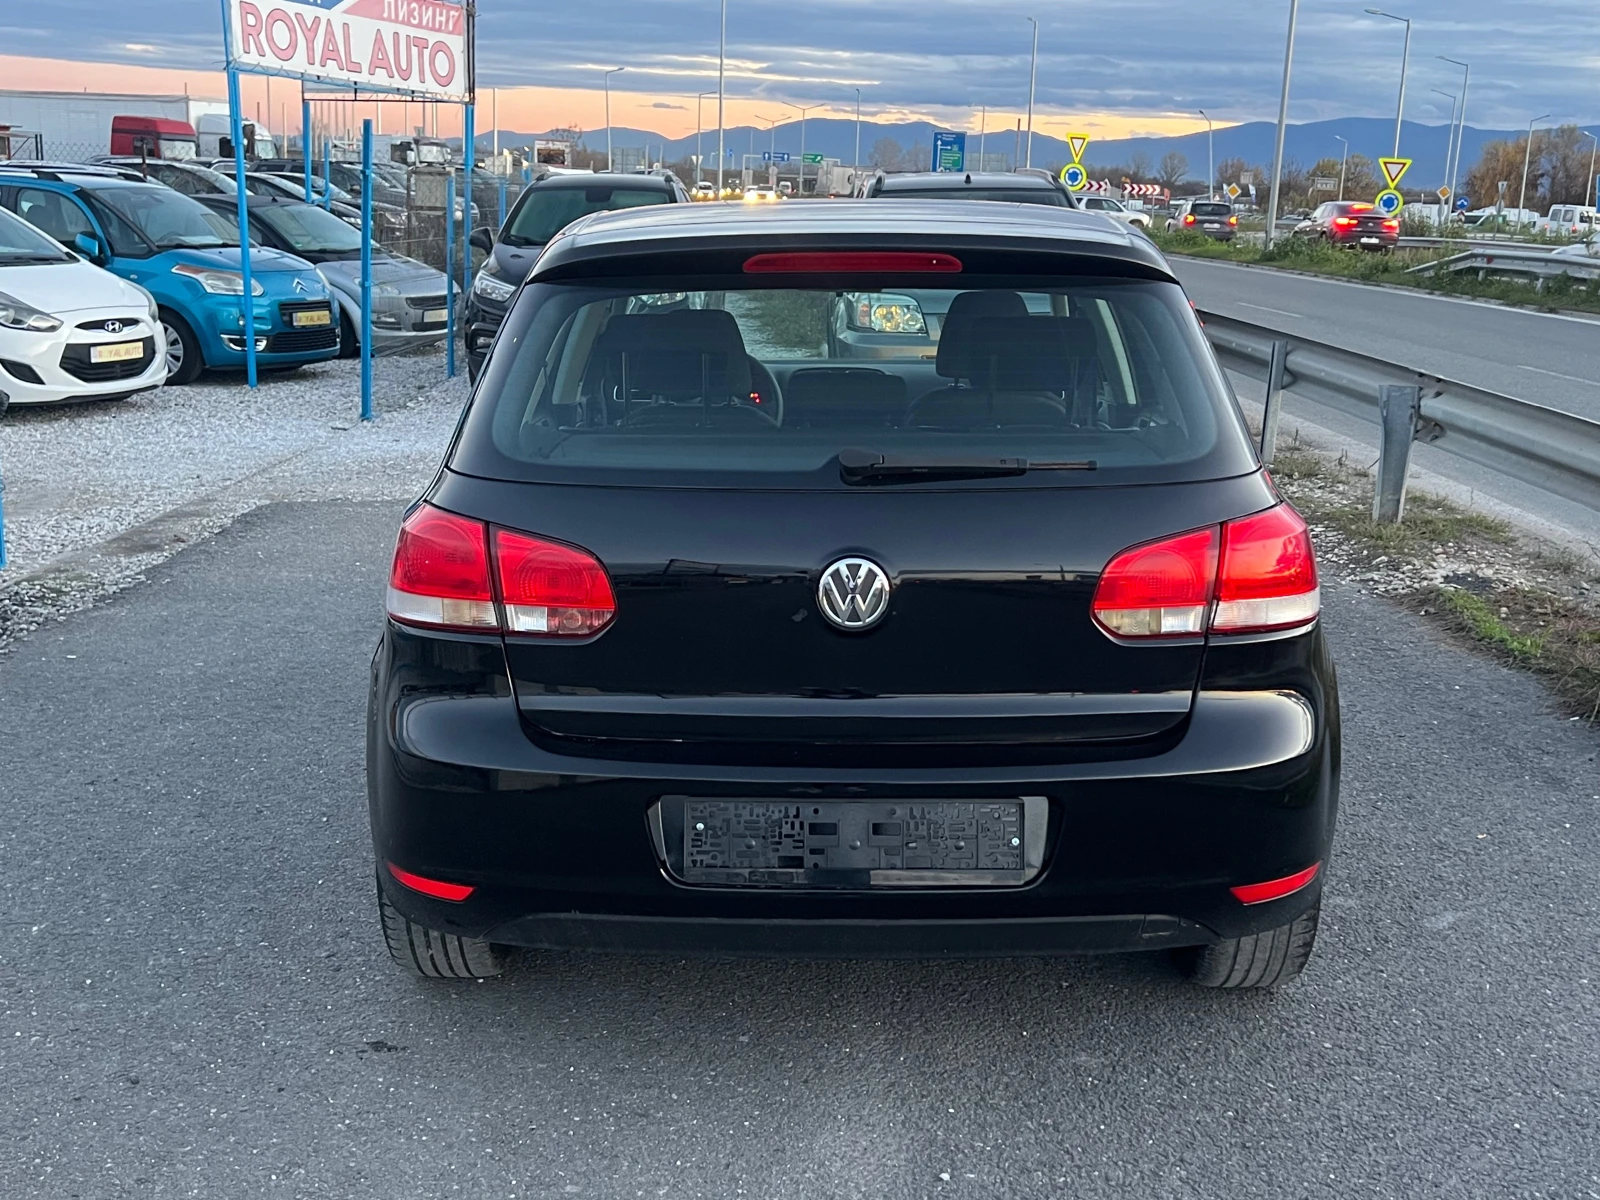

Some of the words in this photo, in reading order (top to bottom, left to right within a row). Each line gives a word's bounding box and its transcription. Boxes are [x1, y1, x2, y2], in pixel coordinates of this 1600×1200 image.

[383, 0, 459, 31] ЛИЗИНГ
[239, 0, 362, 73] ROYAL
[368, 28, 456, 87] AUTO
[97, 348, 122, 359] RYAL
